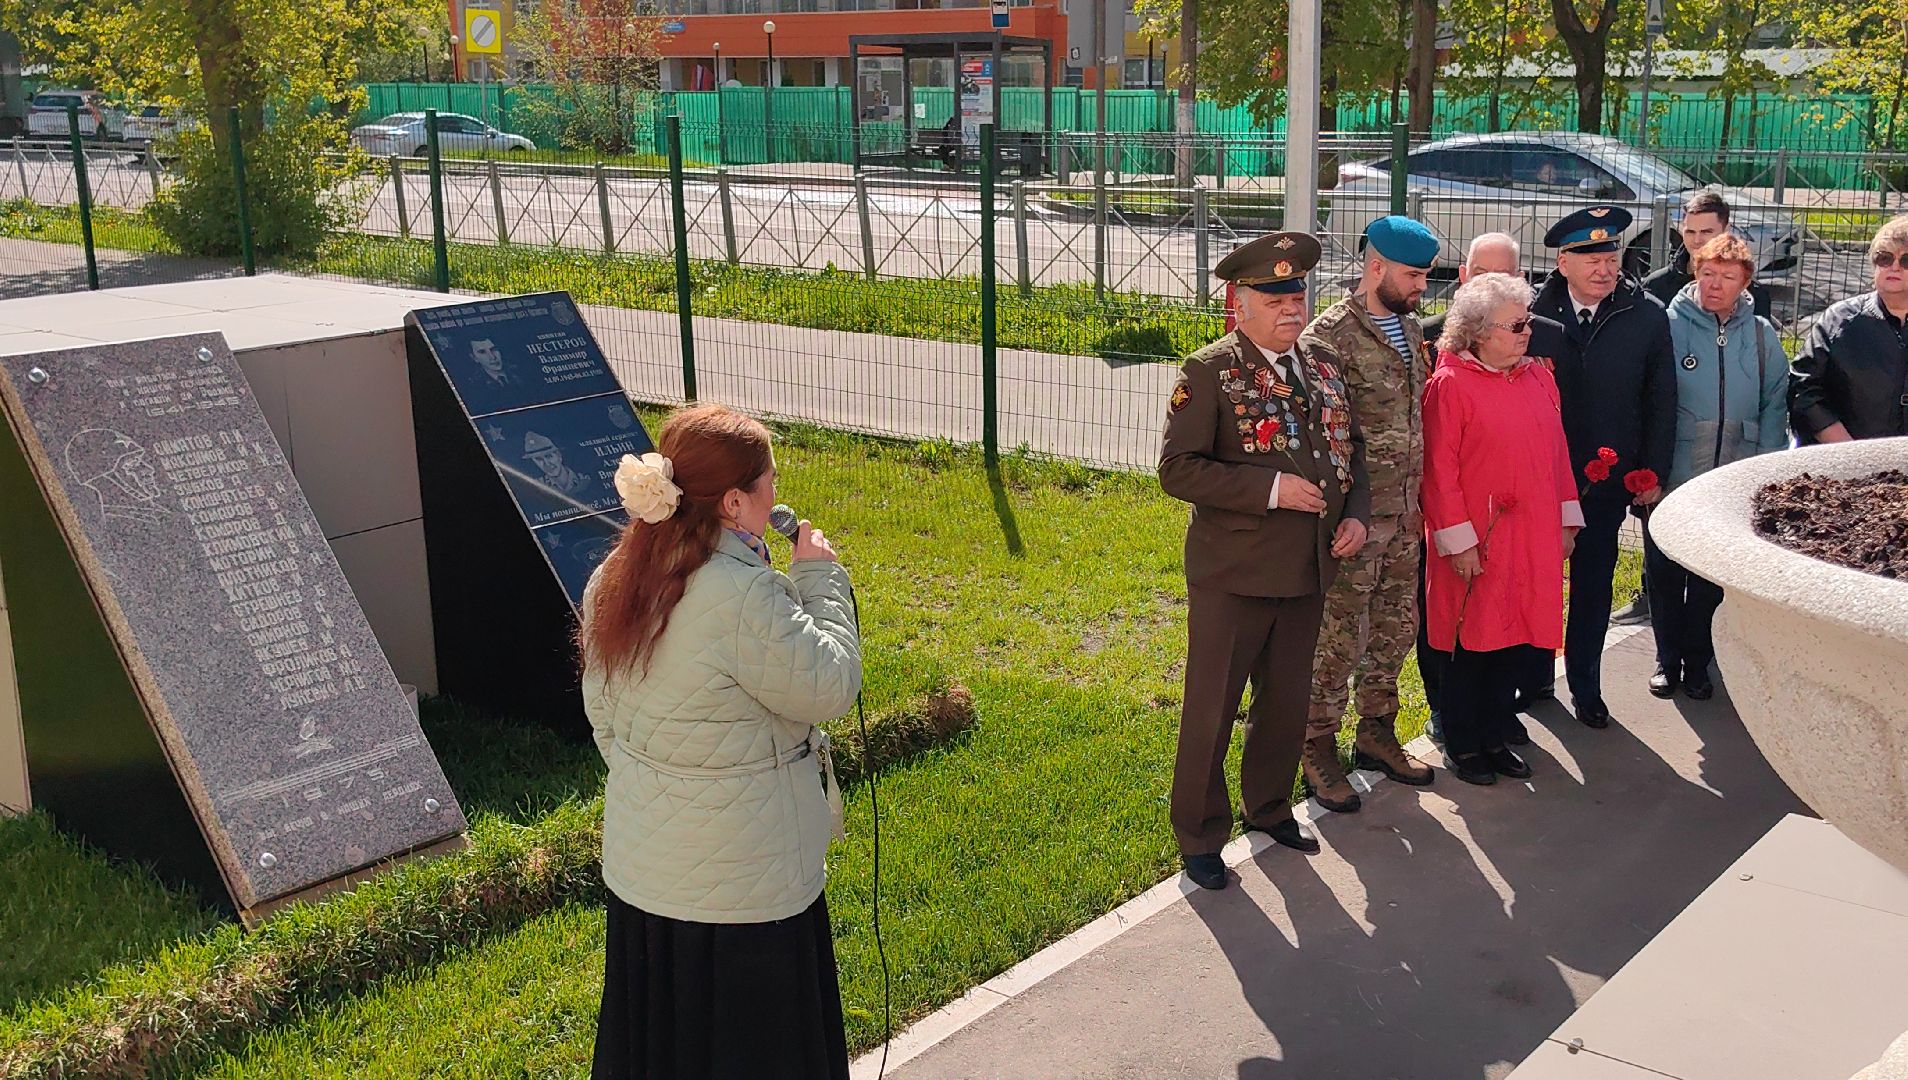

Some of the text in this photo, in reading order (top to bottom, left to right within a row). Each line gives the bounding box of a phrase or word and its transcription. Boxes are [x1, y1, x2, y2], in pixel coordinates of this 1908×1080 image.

[526, 337, 587, 355] НЕСТЕРОВ
[538, 350, 588, 364] Владимир
[160, 448, 226, 471] МАКСИМОВ
[594, 441, 636, 457] ИЛЬИН
[167, 459, 249, 483] ЧЕТВЕРИКОВ
[174, 478, 225, 496] ЗУБКОВ
[181, 485, 265, 511] КОНДРАТЬЕВ
[188, 497, 279, 525] КОМАРОВ В
[534, 513, 550, 522] Мы
[602, 496, 617, 507] Мы
[194, 512, 287, 541] КОМАРОВ Д
[202, 526, 297, 557] КЛИМОВСКИЙ
[209, 540, 300, 572] МОТОРИН В
[217, 557, 298, 587] ПЛОТНИКОВ
[232, 588, 303, 617] СТРЕШНЕВ
[240, 606, 303, 632] СИДОРОВ
[247, 620, 310, 647] СМИРНОВ
[255, 637, 309, 662] ЯКУШЕВ
[262, 647, 338, 677] ФРОЛИКОВ
